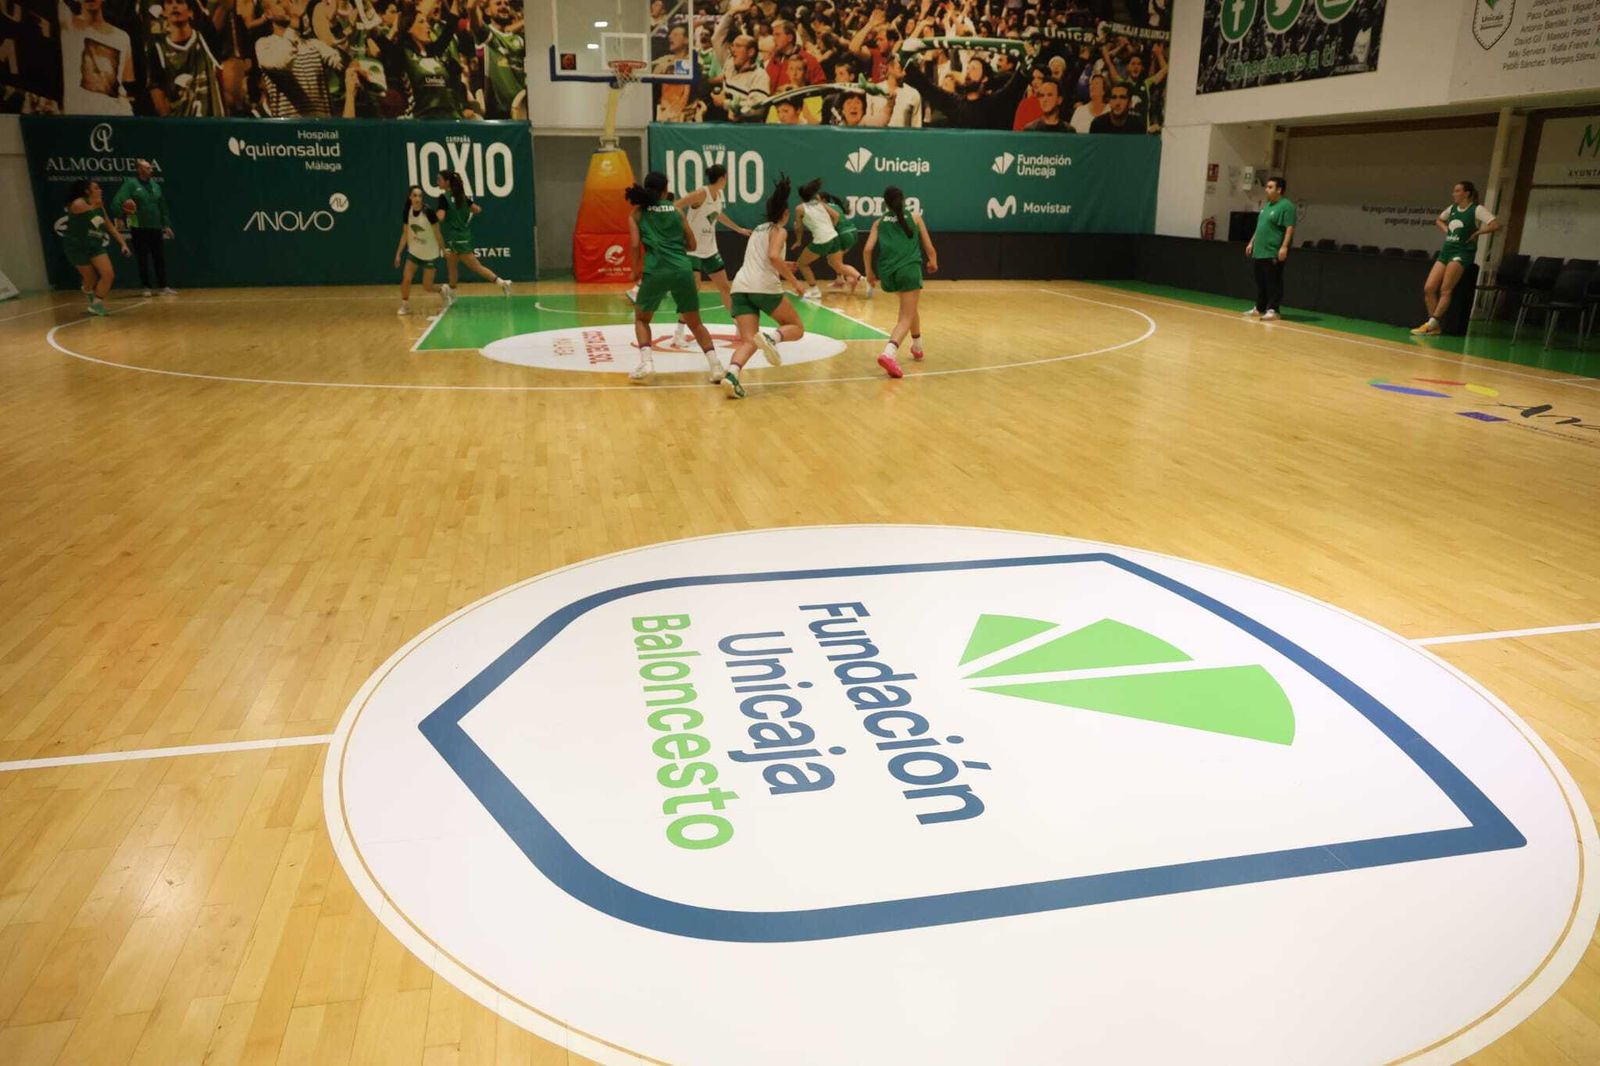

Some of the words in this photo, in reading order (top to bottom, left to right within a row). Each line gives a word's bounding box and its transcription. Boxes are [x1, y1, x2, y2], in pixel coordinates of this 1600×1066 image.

[297, 130, 339, 140] Hospital
[46, 157, 162, 172] ALMOGUEA
[305, 160, 342, 172] Málaga
[874, 157, 930, 176] Unicaja
[1017, 154, 1072, 166] Fundación
[1017, 165, 1056, 178] Unicaja
[1023, 202, 1072, 214] Movistar
[718, 631, 847, 795] Unicaja
[798, 601, 992, 825] Fundación
[631, 613, 741, 850] Baloncesto
